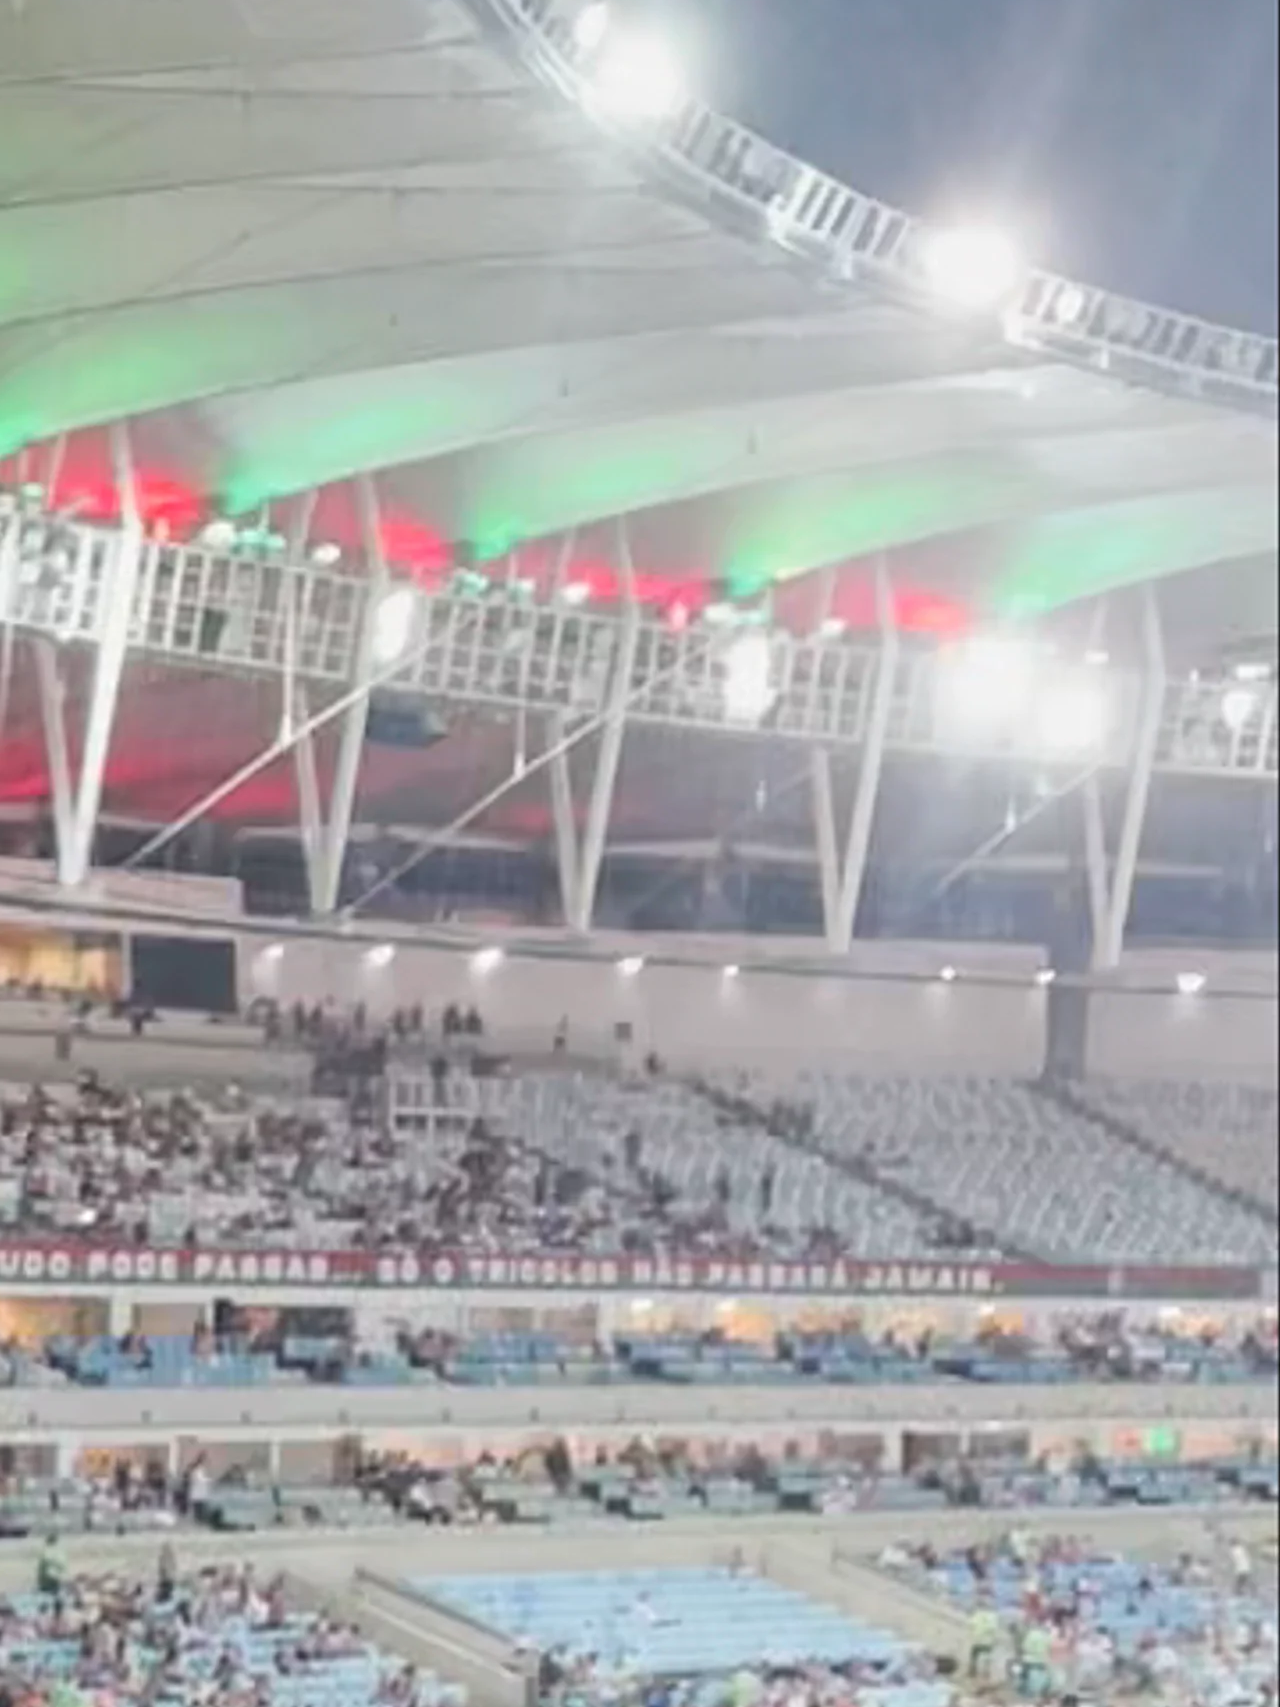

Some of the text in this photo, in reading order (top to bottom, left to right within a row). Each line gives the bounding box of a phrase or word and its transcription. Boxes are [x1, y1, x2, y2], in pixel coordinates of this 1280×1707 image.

[88, 1250, 178, 1281] PODE
[377, 1250, 420, 1284] SÓ
[433, 1255, 454, 1284] O
[467, 1257, 617, 1286] TRICOLOR
[633, 1249, 693, 1286] NÃO
[708, 1258, 847, 1288] PASSARÁ
